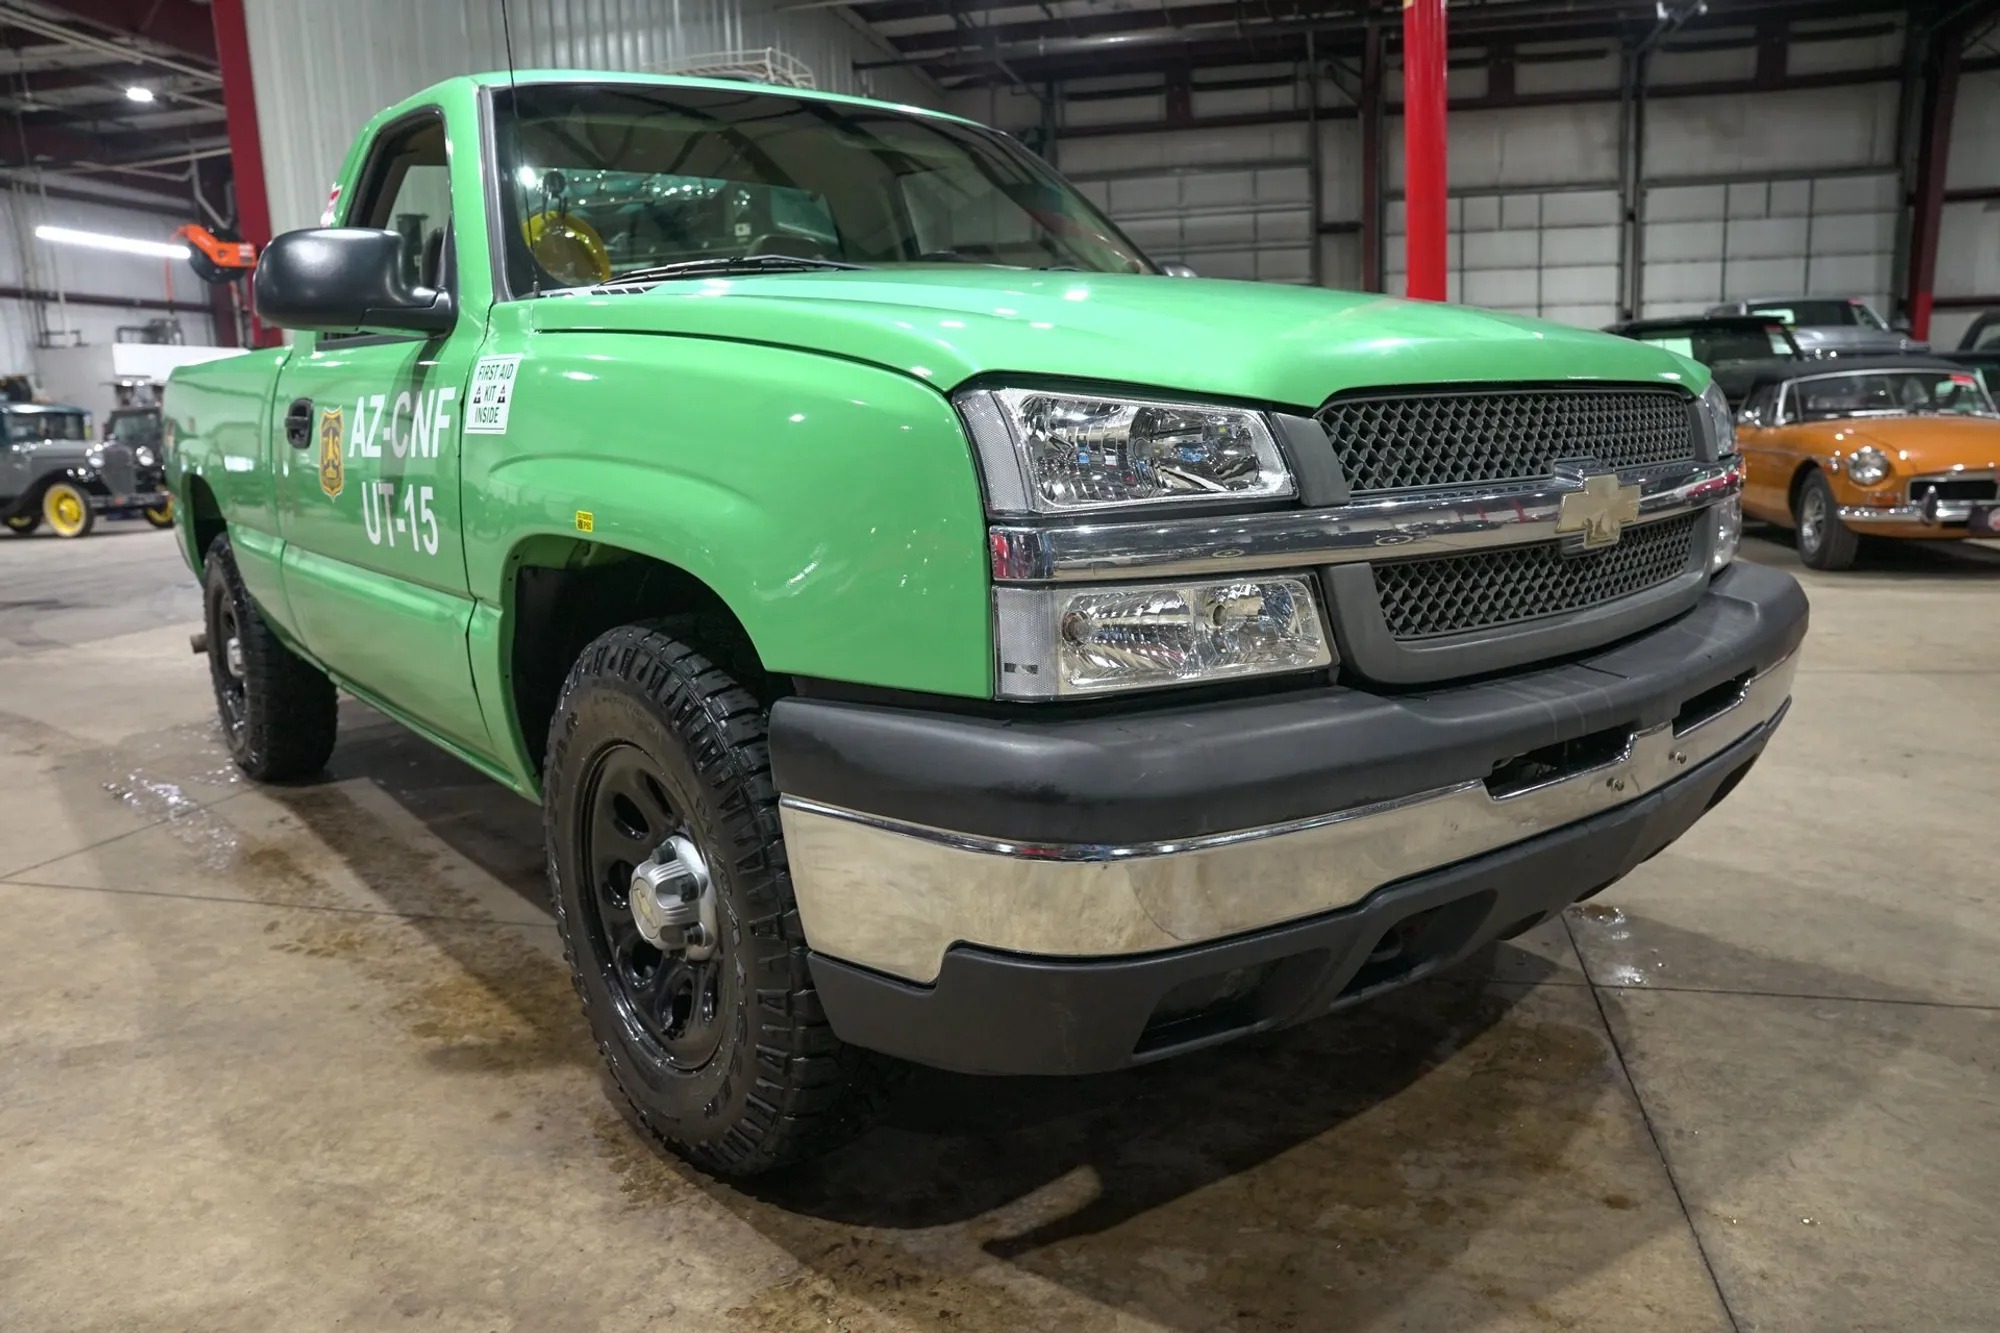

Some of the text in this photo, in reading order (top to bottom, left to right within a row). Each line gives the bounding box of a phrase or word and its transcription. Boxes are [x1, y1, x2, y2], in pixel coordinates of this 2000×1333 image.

[478, 363, 514, 381] FIRST AID
[484, 385, 497, 402] KIT
[348, 387, 456, 458] AZ-CNF
[475, 406, 500, 424] INSIDE
[361, 481, 439, 556] UT-15
